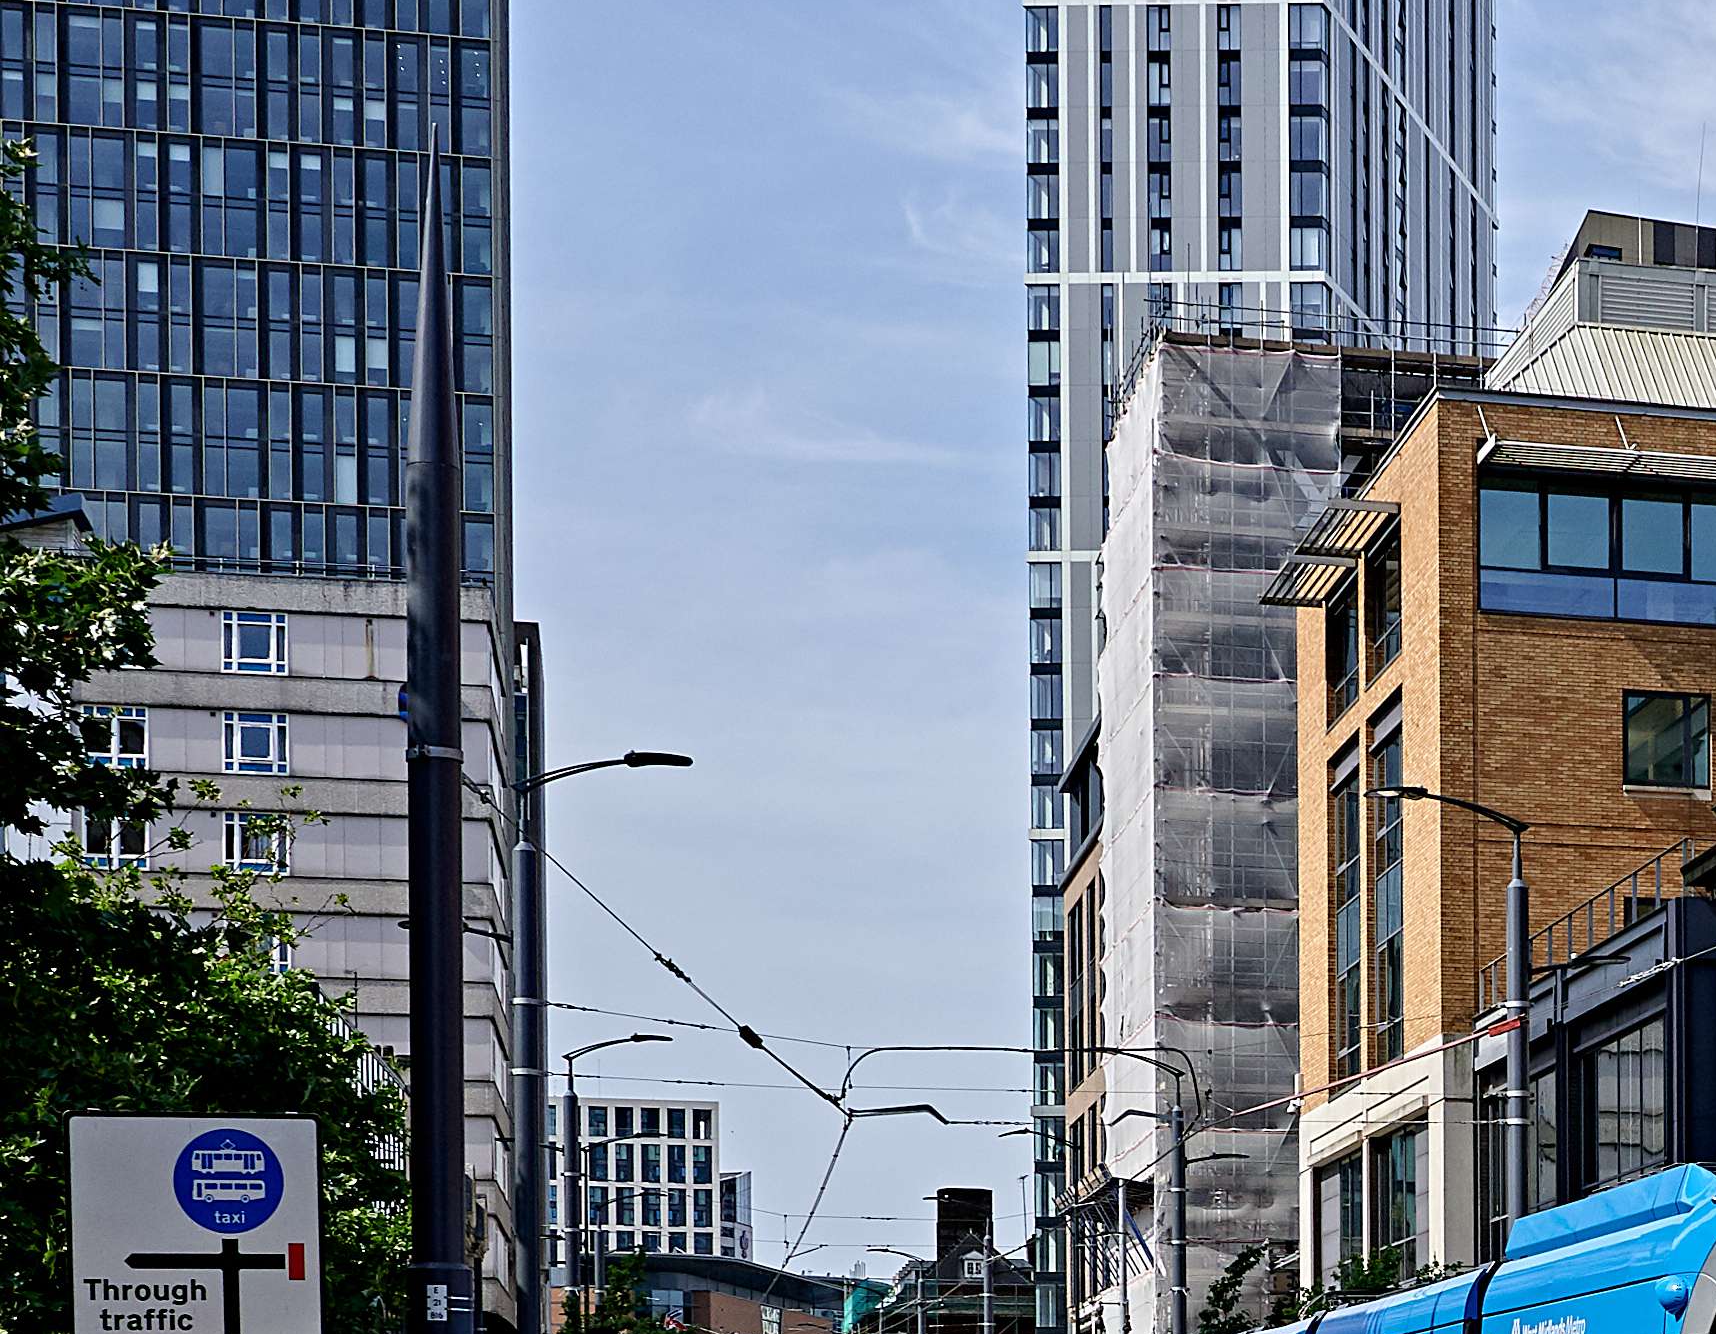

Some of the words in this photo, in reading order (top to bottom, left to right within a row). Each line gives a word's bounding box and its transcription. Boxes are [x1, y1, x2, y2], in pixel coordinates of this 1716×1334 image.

[214, 1210, 246, 1224] taxi
[83, 1278, 207, 1305] Through
[100, 1309, 194, 1331] traffic
